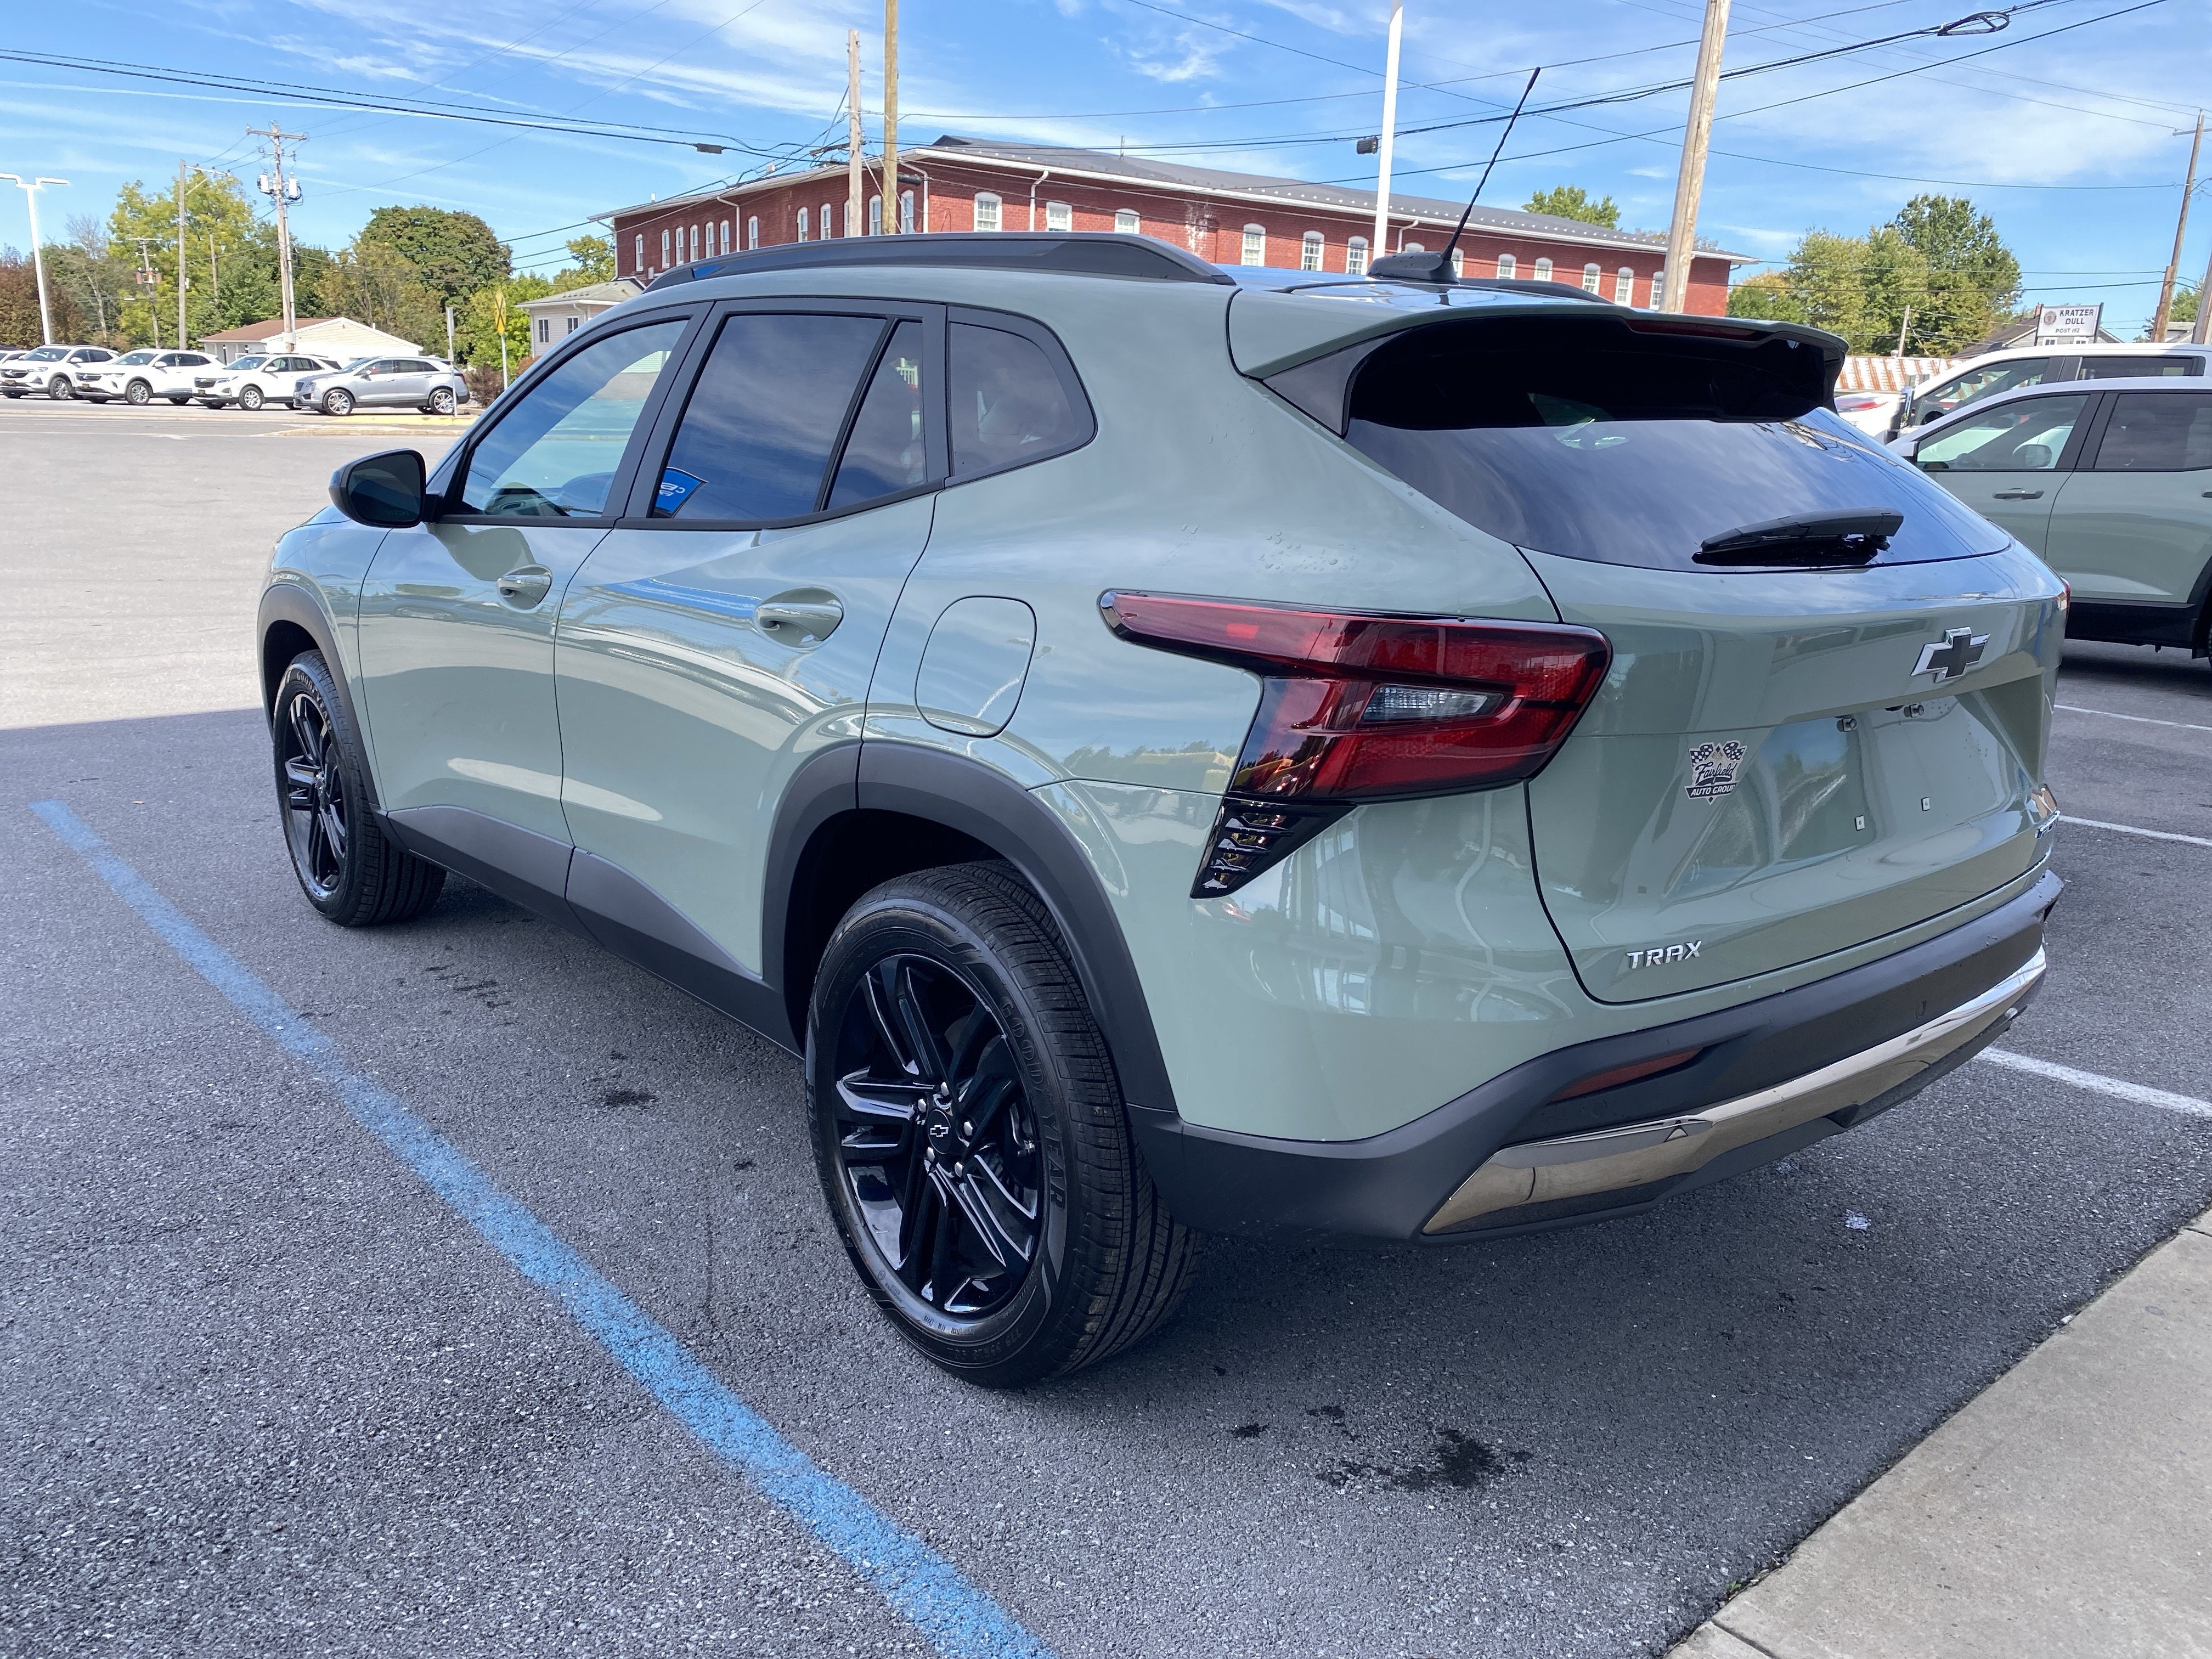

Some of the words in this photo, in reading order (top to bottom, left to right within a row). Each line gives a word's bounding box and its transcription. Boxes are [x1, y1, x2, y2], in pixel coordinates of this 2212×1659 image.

[1695, 761, 1738, 786] Fairfield
[1690, 787, 1711, 797] AUTO
[1626, 940, 1702, 969] TRAX
